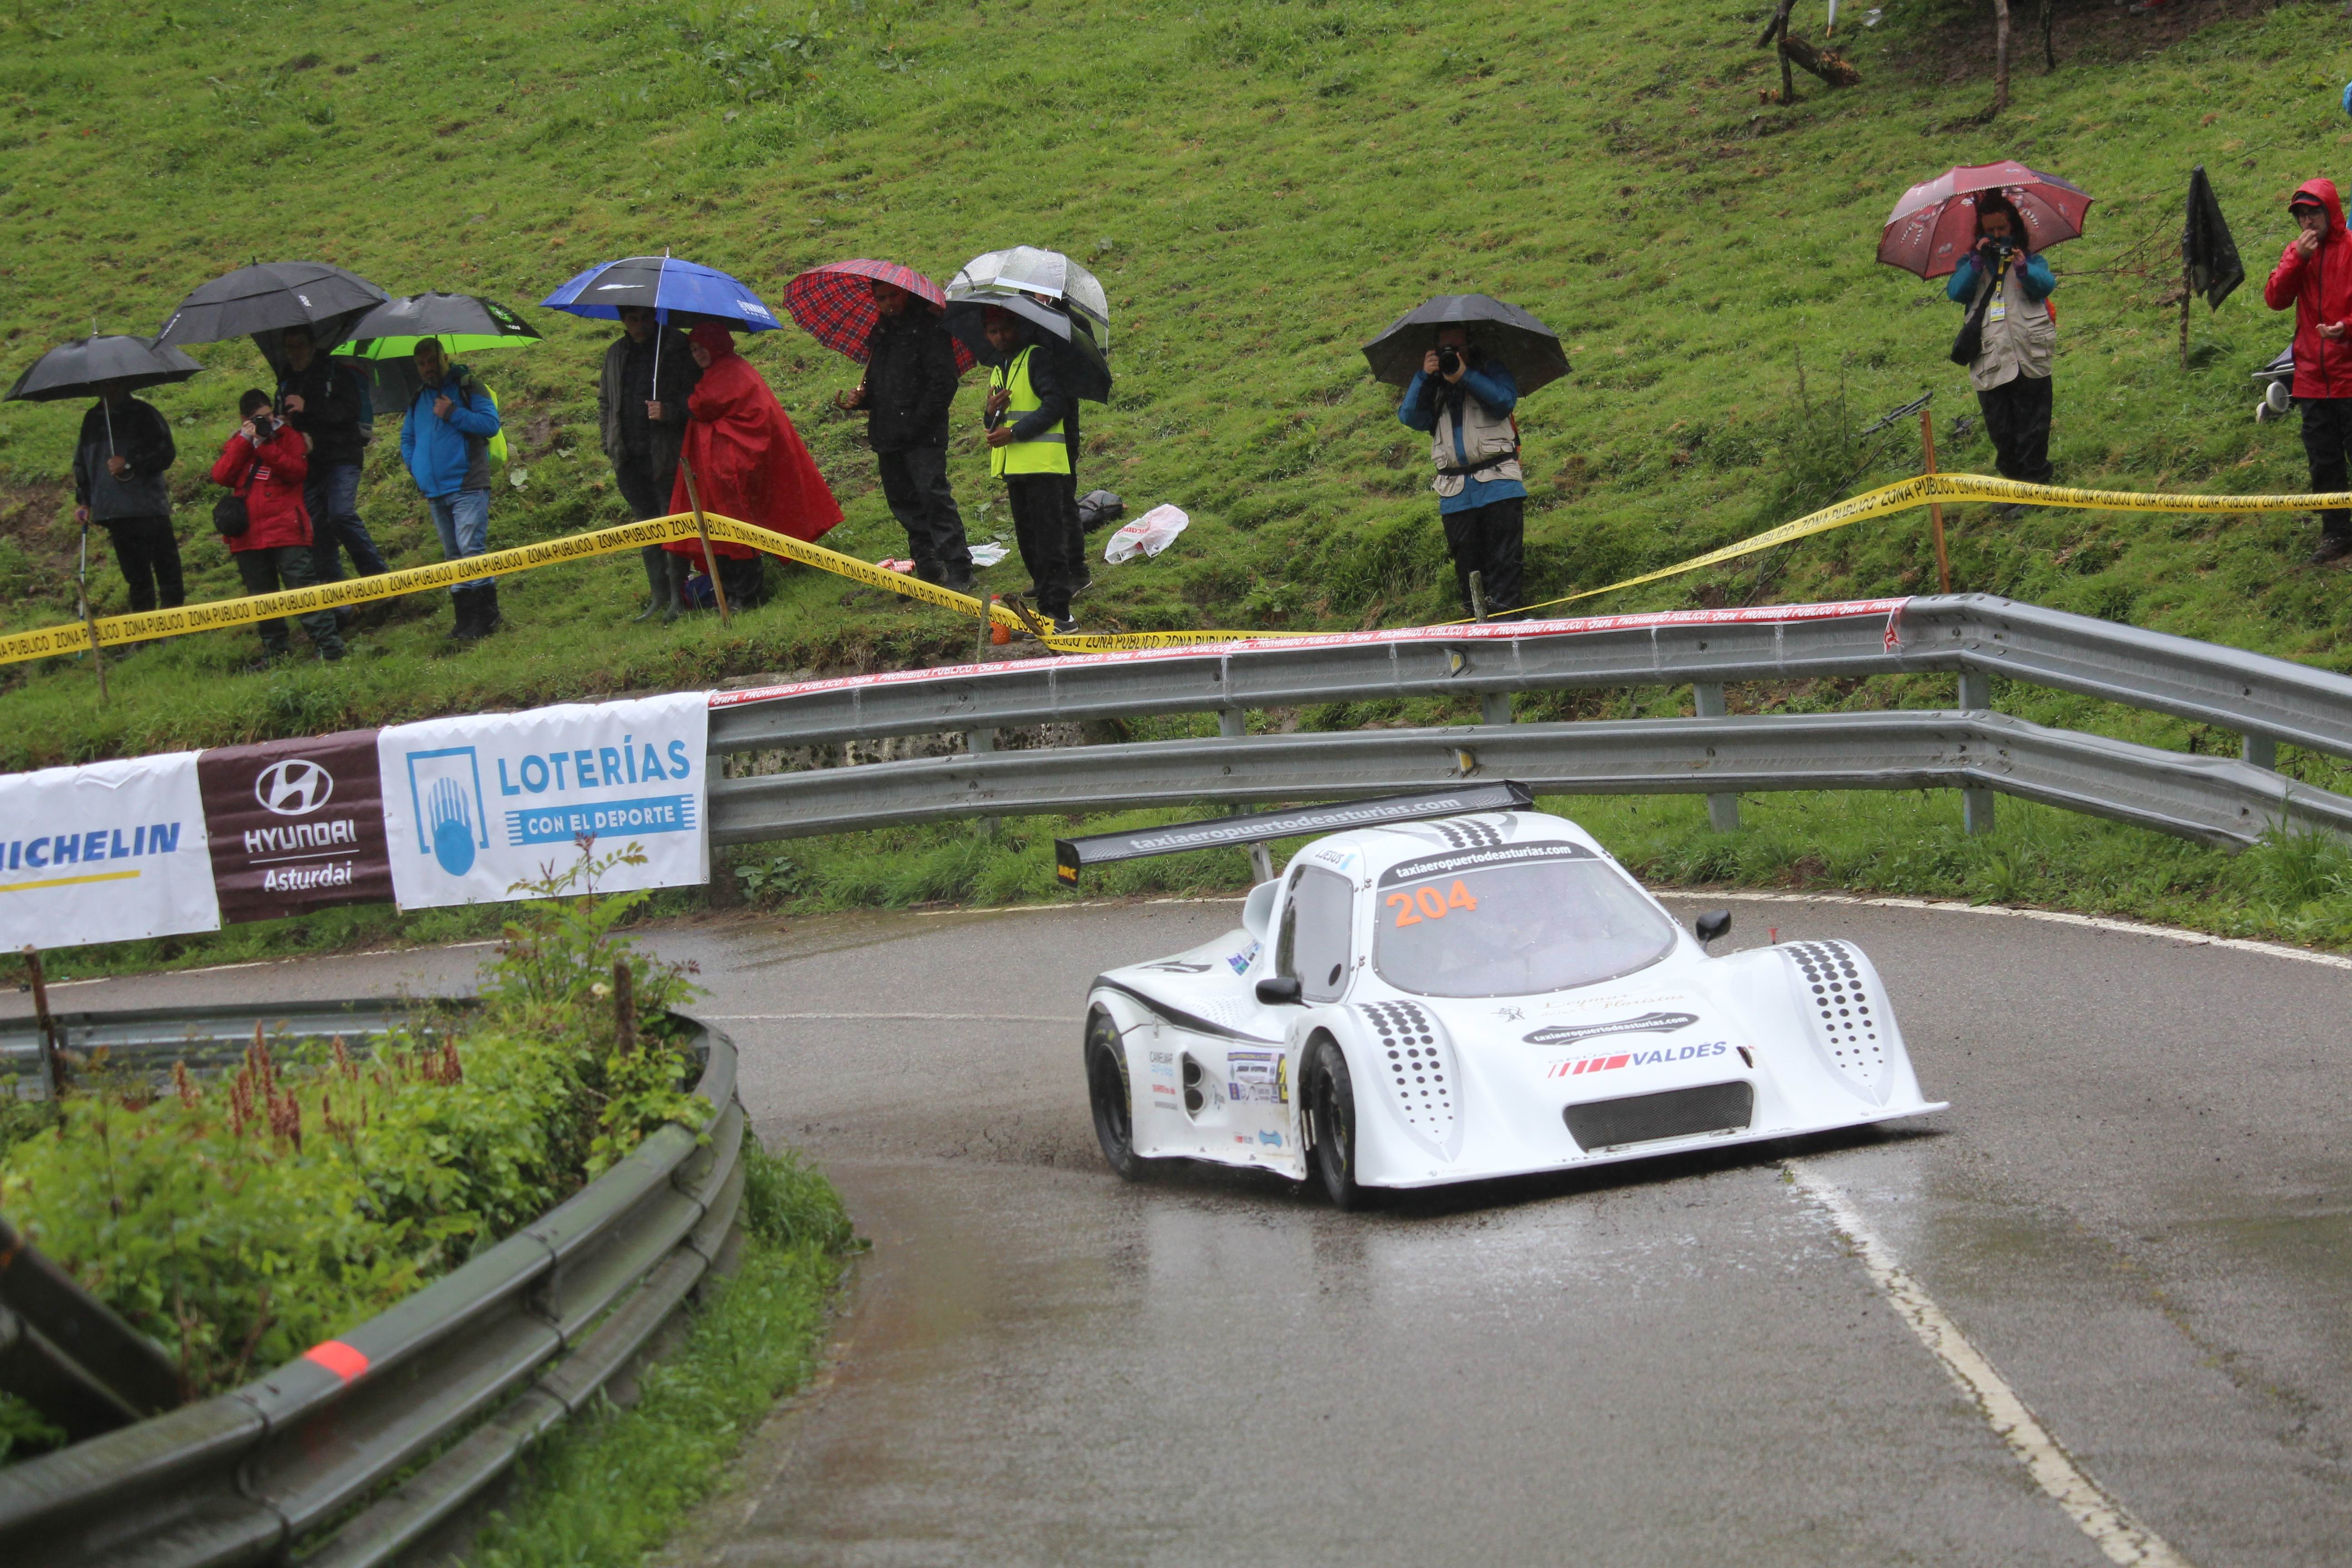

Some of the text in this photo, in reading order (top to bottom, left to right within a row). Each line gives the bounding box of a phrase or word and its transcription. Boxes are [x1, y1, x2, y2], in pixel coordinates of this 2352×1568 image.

[1882, 485, 1915, 506] ZONA
[1915, 477, 1954, 496] PUBLICO
[1955, 479, 1976, 495] ZONA
[1975, 480, 2010, 498] PUBLICO
[2013, 483, 2033, 500] ZONA
[8, 636, 49, 656] PUBLICO
[55, 629, 82, 648] ZONA
[124, 618, 148, 637] ZONA
[148, 613, 184, 632] PUBLICO
[188, 608, 212, 627] ZONA
[213, 603, 250, 622] PUBLICO
[254, 599, 277, 616] ZONA
[279, 592, 317, 612] PUBLICO
[321, 587, 345, 604] ZONA
[347, 579, 384, 599] PUBLICO
[389, 573, 414, 591] ZONA
[414, 566, 453, 588] PUBLICO
[457, 559, 482, 578] ZONA
[483, 551, 523, 574] PUBLICO
[526, 546, 552, 564] ZONA
[553, 537, 594, 560] PUBLICO
[596, 531, 623, 549] ZONA
[623, 523, 666, 542] PUBLICO
[668, 519, 699, 536] ZONA
[732, 525, 754, 542] ZONA
[752, 532, 785, 553] PUBLICO
[785, 543, 806, 560] ZONA
[806, 549, 839, 572] PUBLICO
[841, 561, 862, 580] ZONA
[862, 568, 896, 591] PUBLICO
[898, 580, 919, 599] ZONA
[919, 587, 953, 609] PUBLICO
[955, 599, 980, 618] ZONA
[743, 685, 796, 700] PROHIBIDO
[878, 669, 930, 681] PROHIBIDO
[1008, 657, 1061, 669] PROHIBIDO
[1136, 647, 1188, 658] PROHIBIDO
[1377, 629, 1425, 639] PROHIBIDO
[1495, 622, 1542, 635] PROHIBIDO
[1616, 613, 1669, 625] PROHIBIDO
[1740, 607, 1791, 619] PROHIBIDO
[1086, 635, 1112, 648] ZONA
[1115, 635, 1160, 649] PUBLICO
[1162, 635, 1192, 648] ZONA
[498, 735, 691, 796] LOTERÍAS
[245, 819, 358, 853] HYUNDAI
[528, 805, 675, 835] CON EL DEPORTE
[1131, 797, 1461, 849] taxiaeropuertodeasturias.com
[0, 822, 181, 870] ICHELIN
[1396, 844, 1572, 878] taxiaeropuertodeasturias.com
[264, 861, 353, 892] Asturdai
[1386, 880, 1478, 927] 204
[1534, 1016, 1689, 1042] taxiaeropuertodeasturias.com
[1633, 1041, 1727, 1066] VALDÉS
